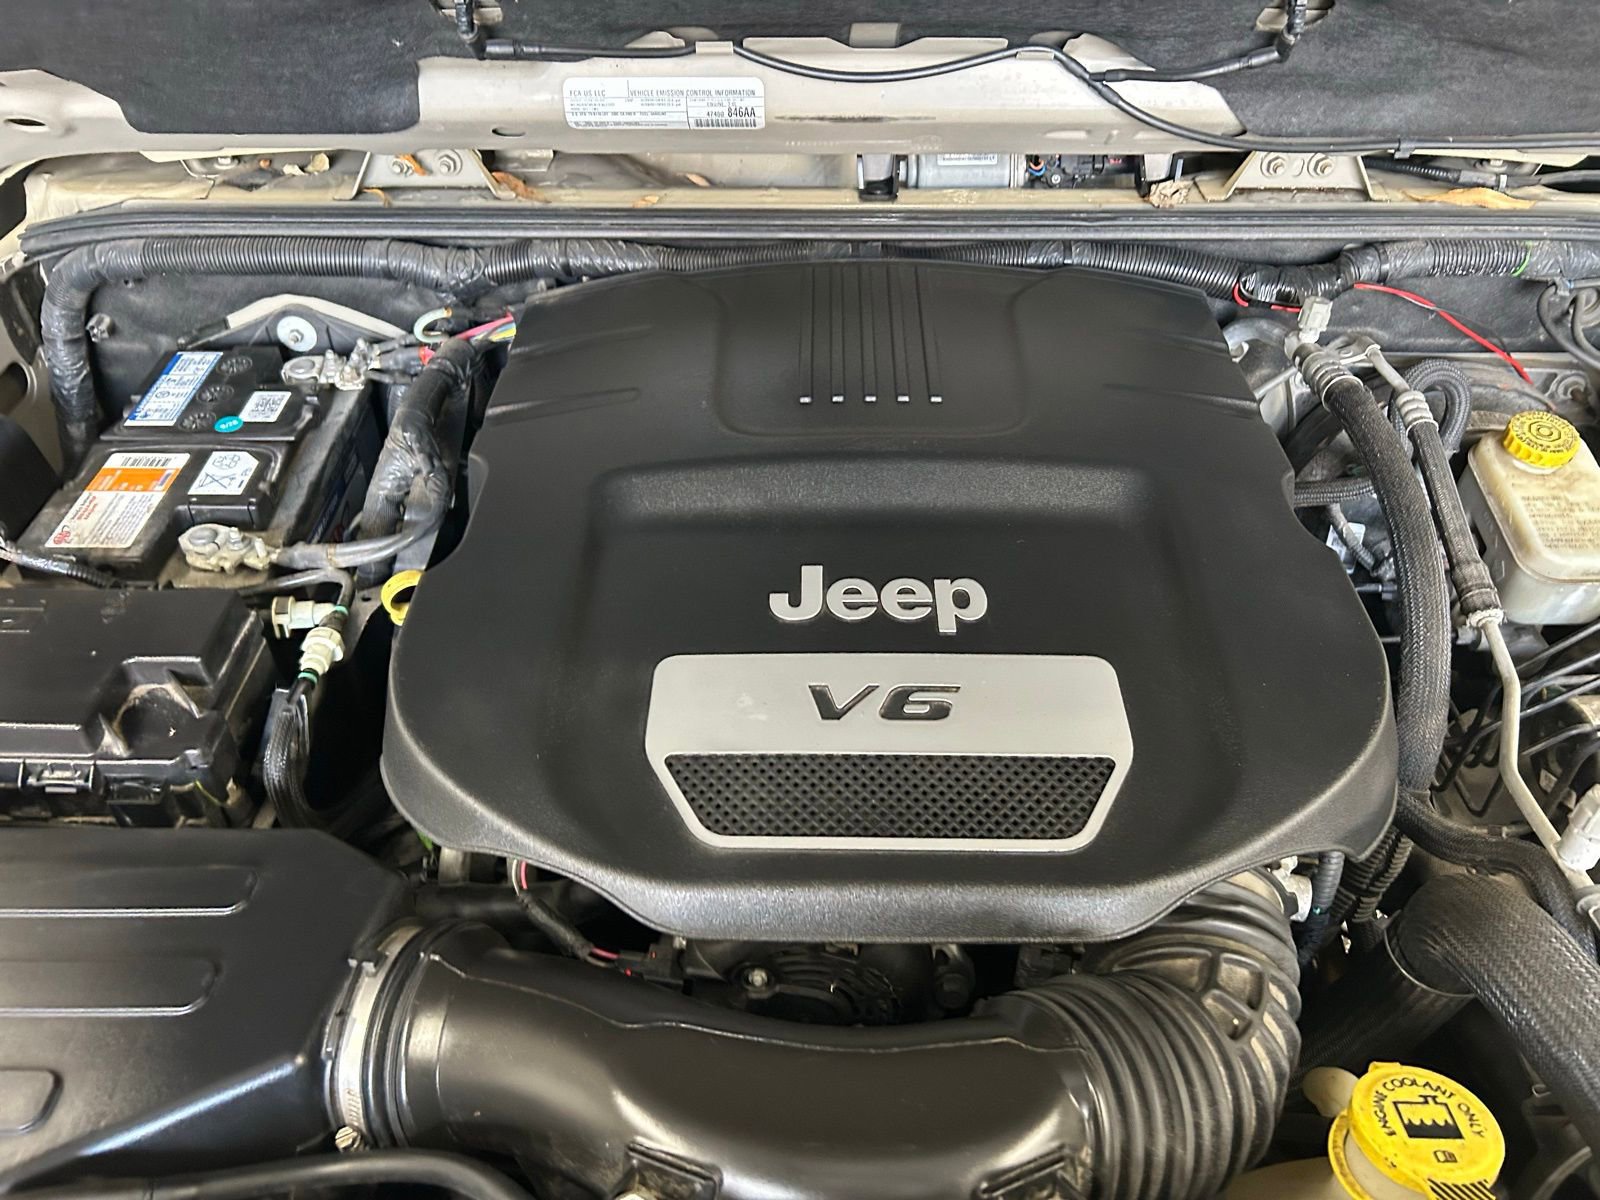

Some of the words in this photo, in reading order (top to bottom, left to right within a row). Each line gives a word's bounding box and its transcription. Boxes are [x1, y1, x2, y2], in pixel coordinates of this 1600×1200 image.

[569, 89, 582, 97] FCA
[583, 89, 592, 97] US
[594, 89, 606, 97] LLC
[629, 89, 654, 97] VEHICLE
[656, 89, 685, 97] EMISSION
[727, 106, 756, 118] 846AA
[768, 564, 988, 635] Jeep
[808, 683, 961, 721] V6
[1383, 1077, 1457, 1100] COOLANT
[1371, 1090, 1397, 1137] ENGINE
[1457, 1103, 1486, 1138] ONLY
